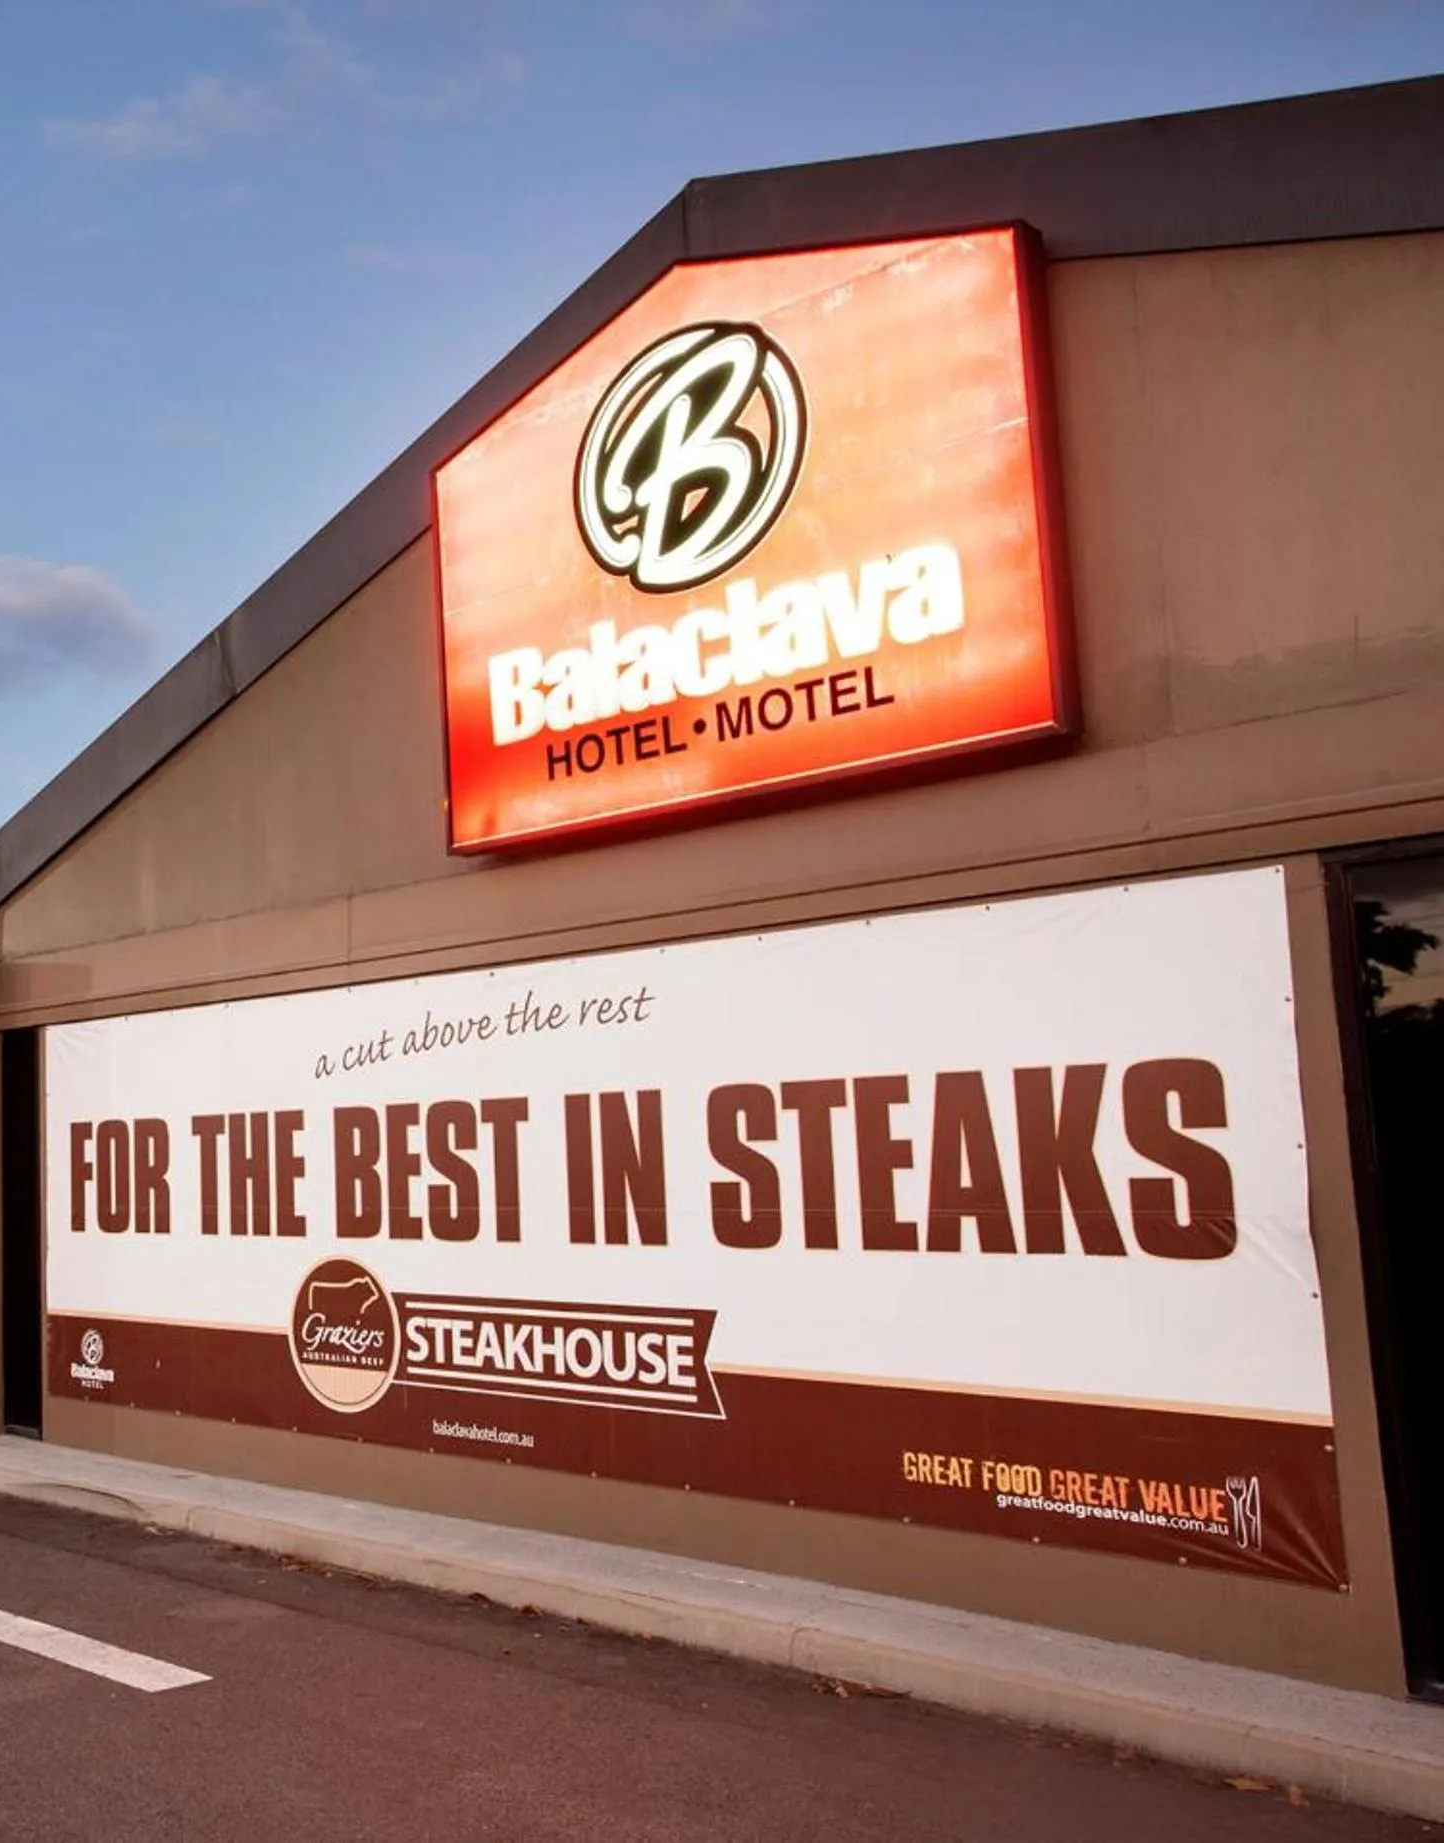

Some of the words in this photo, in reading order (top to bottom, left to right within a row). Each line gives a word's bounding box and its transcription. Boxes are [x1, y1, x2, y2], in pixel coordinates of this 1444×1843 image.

[488, 542, 965, 746] Balaclava
[546, 716, 688, 780] HOTEL
[715, 665, 895, 742] MOTEL
[314, 1053, 335, 1079] a
[341, 1029, 395, 1071] cut
[401, 1010, 500, 1056] above
[503, 990, 571, 1035] the
[577, 986, 657, 1027] rest
[70, 1118, 171, 1234] FOR
[192, 1108, 307, 1238] THE
[333, 1097, 529, 1243] BEST
[564, 1088, 668, 1247] IN
[706, 1057, 1238, 1261] STEAKS
[301, 1312, 386, 1355] Graziers
[406, 1316, 697, 1388] STEAKHOUSE
[432, 1419, 535, 1448] balaclavahotel.com.au
[903, 1451, 974, 1488] GREAT
[981, 1460, 1043, 1498] FOOD
[1049, 1469, 1130, 1509] GREAT
[1138, 1479, 1229, 1524] VALUE
[996, 1492, 1230, 1537] greatfoodgreatvalue.com.au
